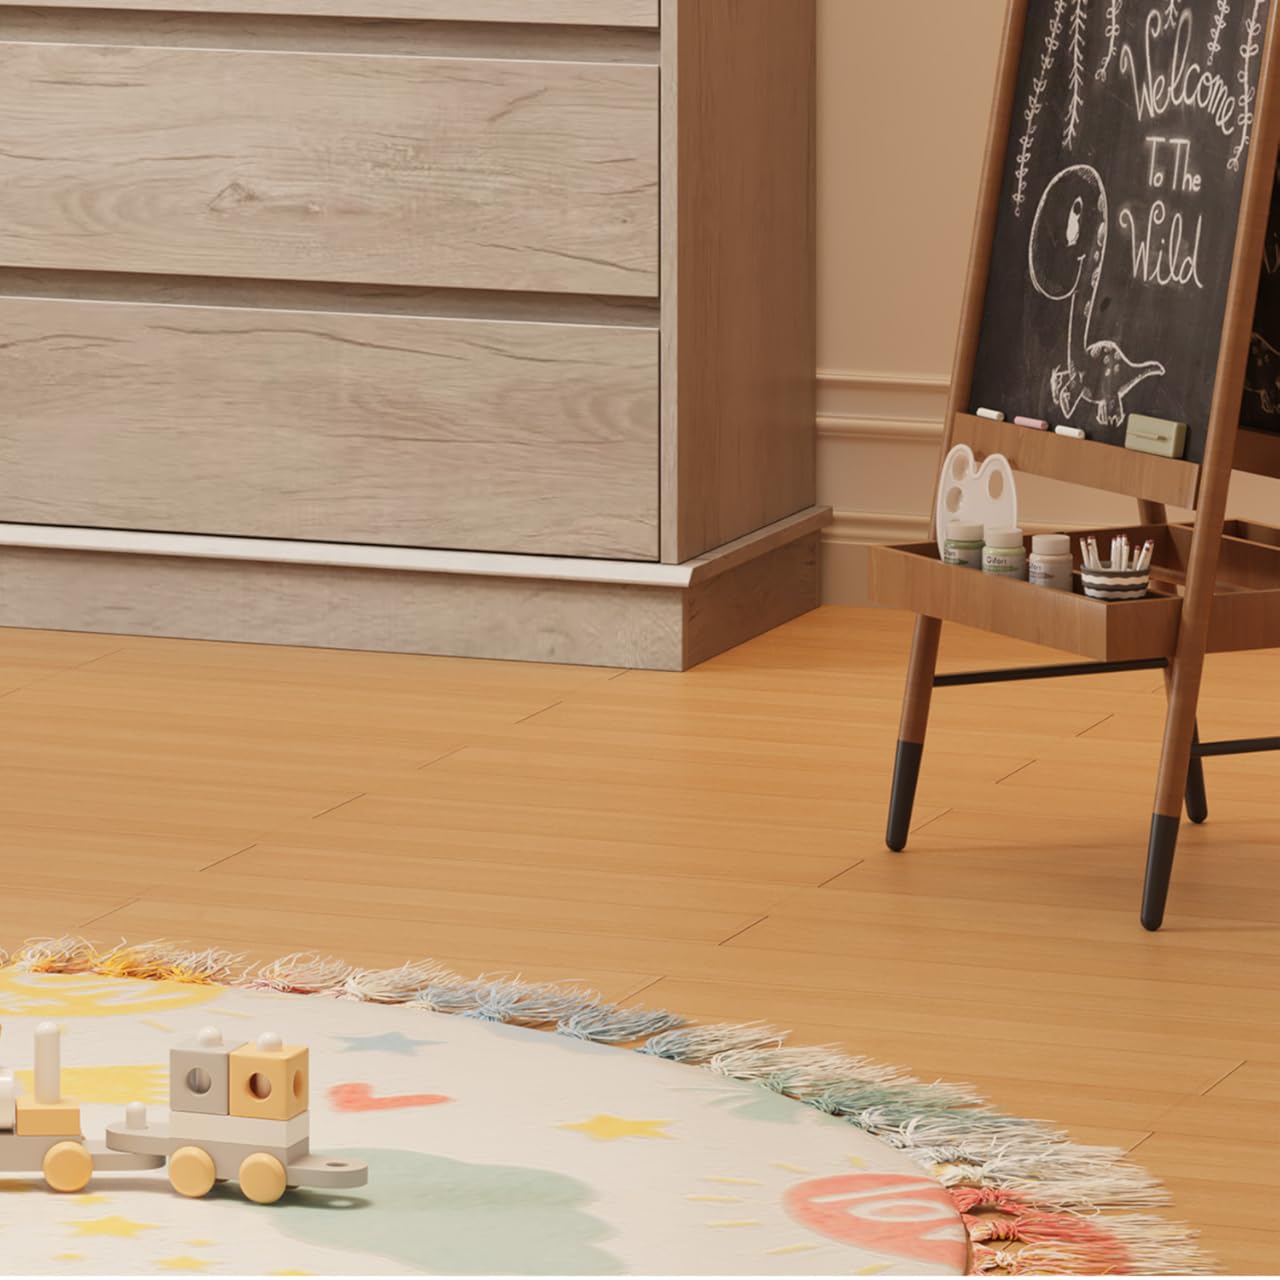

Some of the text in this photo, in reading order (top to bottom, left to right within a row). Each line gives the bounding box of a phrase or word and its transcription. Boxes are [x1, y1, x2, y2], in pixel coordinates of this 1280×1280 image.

[1119, 7, 1236, 136] Welcome
[1145, 136, 1202, 192] To The
[1119, 199, 1204, 289] Wild
